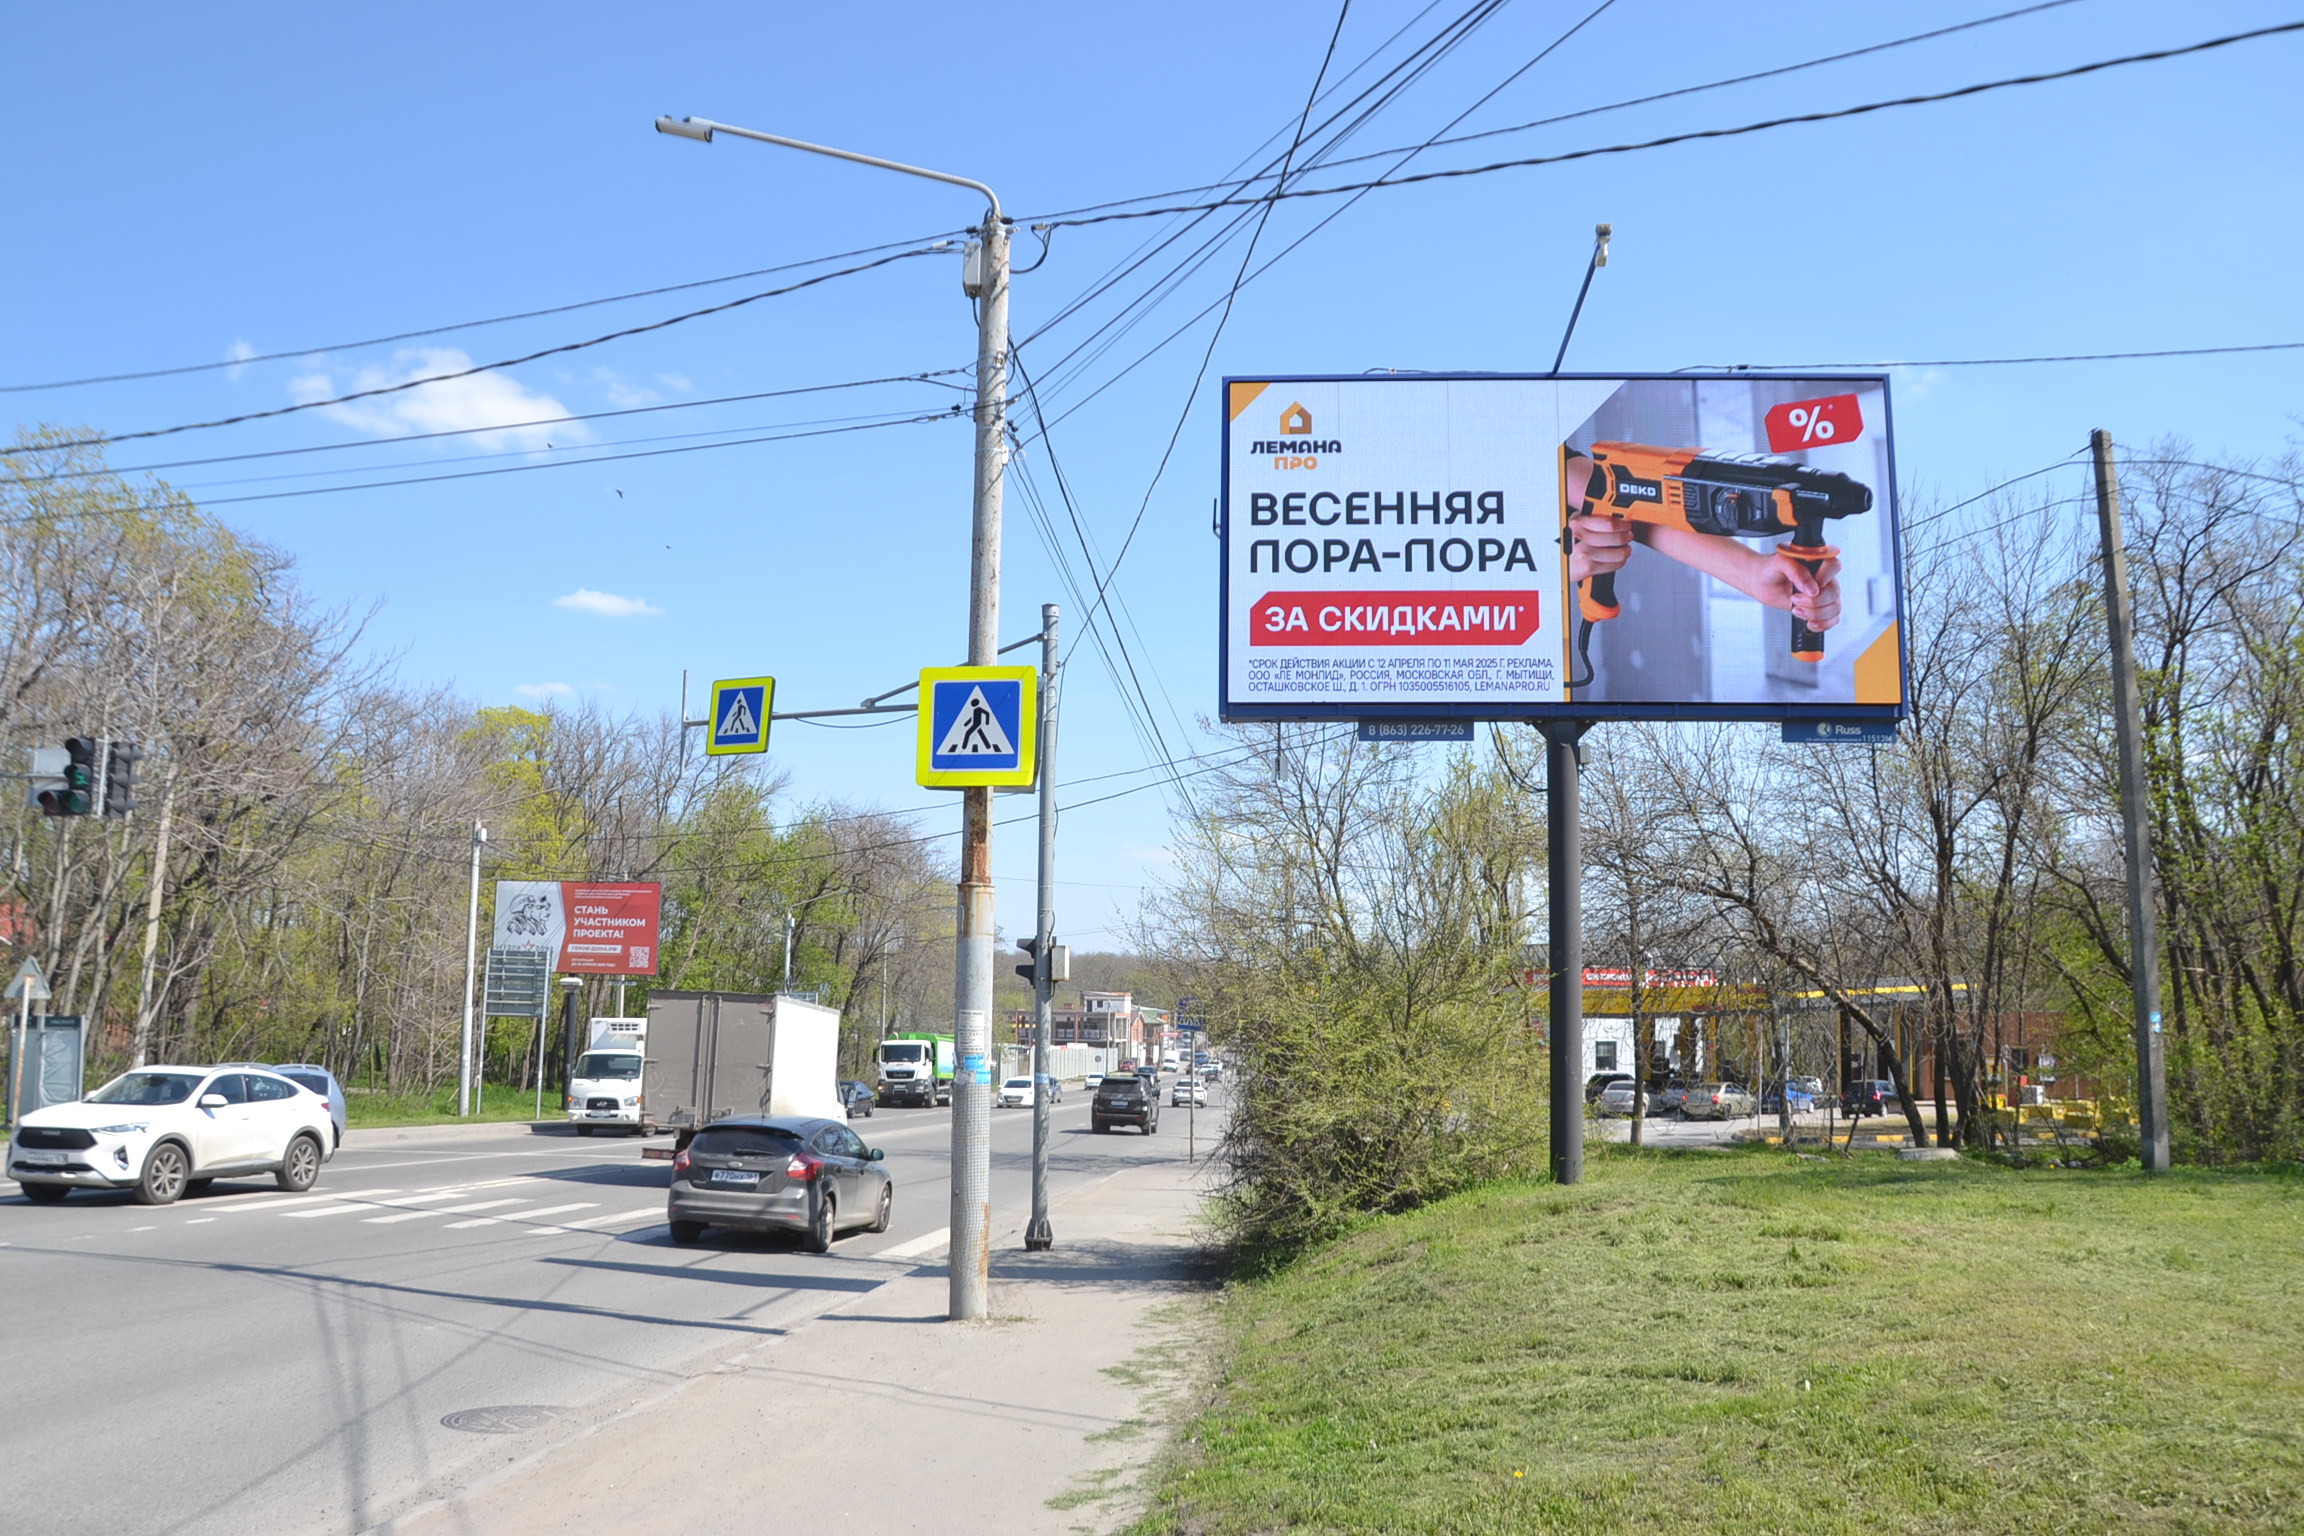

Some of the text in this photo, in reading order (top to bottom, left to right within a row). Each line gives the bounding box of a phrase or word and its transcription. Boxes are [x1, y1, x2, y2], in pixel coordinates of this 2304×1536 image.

[1250, 440, 1342, 454] ЛЕМАНА
[1274, 456, 1318, 470] ПРО
[1619, 483, 1656, 496] DEKO
[1250, 491, 1504, 526] ВЕСЕННЯЯ
[1250, 537, 1537, 573] ПОРА-ПОРА
[1265, 606, 1309, 632] ЗА
[1280, 657, 1330, 669] ДЕЙСТВИЯ
[1332, 659, 1366, 669] АКЦИИ
[1368, 659, 1375, 668] С
[1377, 659, 1385, 668] 12
[1388, 659, 1425, 668] АПРЕЛЯ
[1427, 659, 1441, 668] ПО
[1443, 659, 1451, 668] 11
[1453, 659, 1473, 668] МАЯ
[1475, 658, 1498, 668] 2025
[1507, 658, 1554, 668] РЕКЛАМА.
[1248, 670, 1270, 680] ООО
[1274, 671, 1292, 680] «ЛЕ
[1350, 670, 1392, 681] РОССИЯ,
[1396, 670, 1463, 680] МОСКОВСКАЯ
[1506, 670, 1554, 681] МЫТИЩИ,
[1248, 682, 1330, 692] ОСТАШКОВСКОЕ
[1349, 682, 1359, 693] Д.
[1370, 682, 1396, 692] ОГРН
[1474, 681, 1550, 691] LEMANAPRO.RU
[1368, 723, 1464, 736] 8 (863) 226-77-26
[1835, 725, 1861, 735] Russ
[574, 905, 608, 915] СТАНЬ
[574, 917, 646, 928] УЧАСТНИКОМ
[573, 928, 624, 938] ПРОЕКТА!
